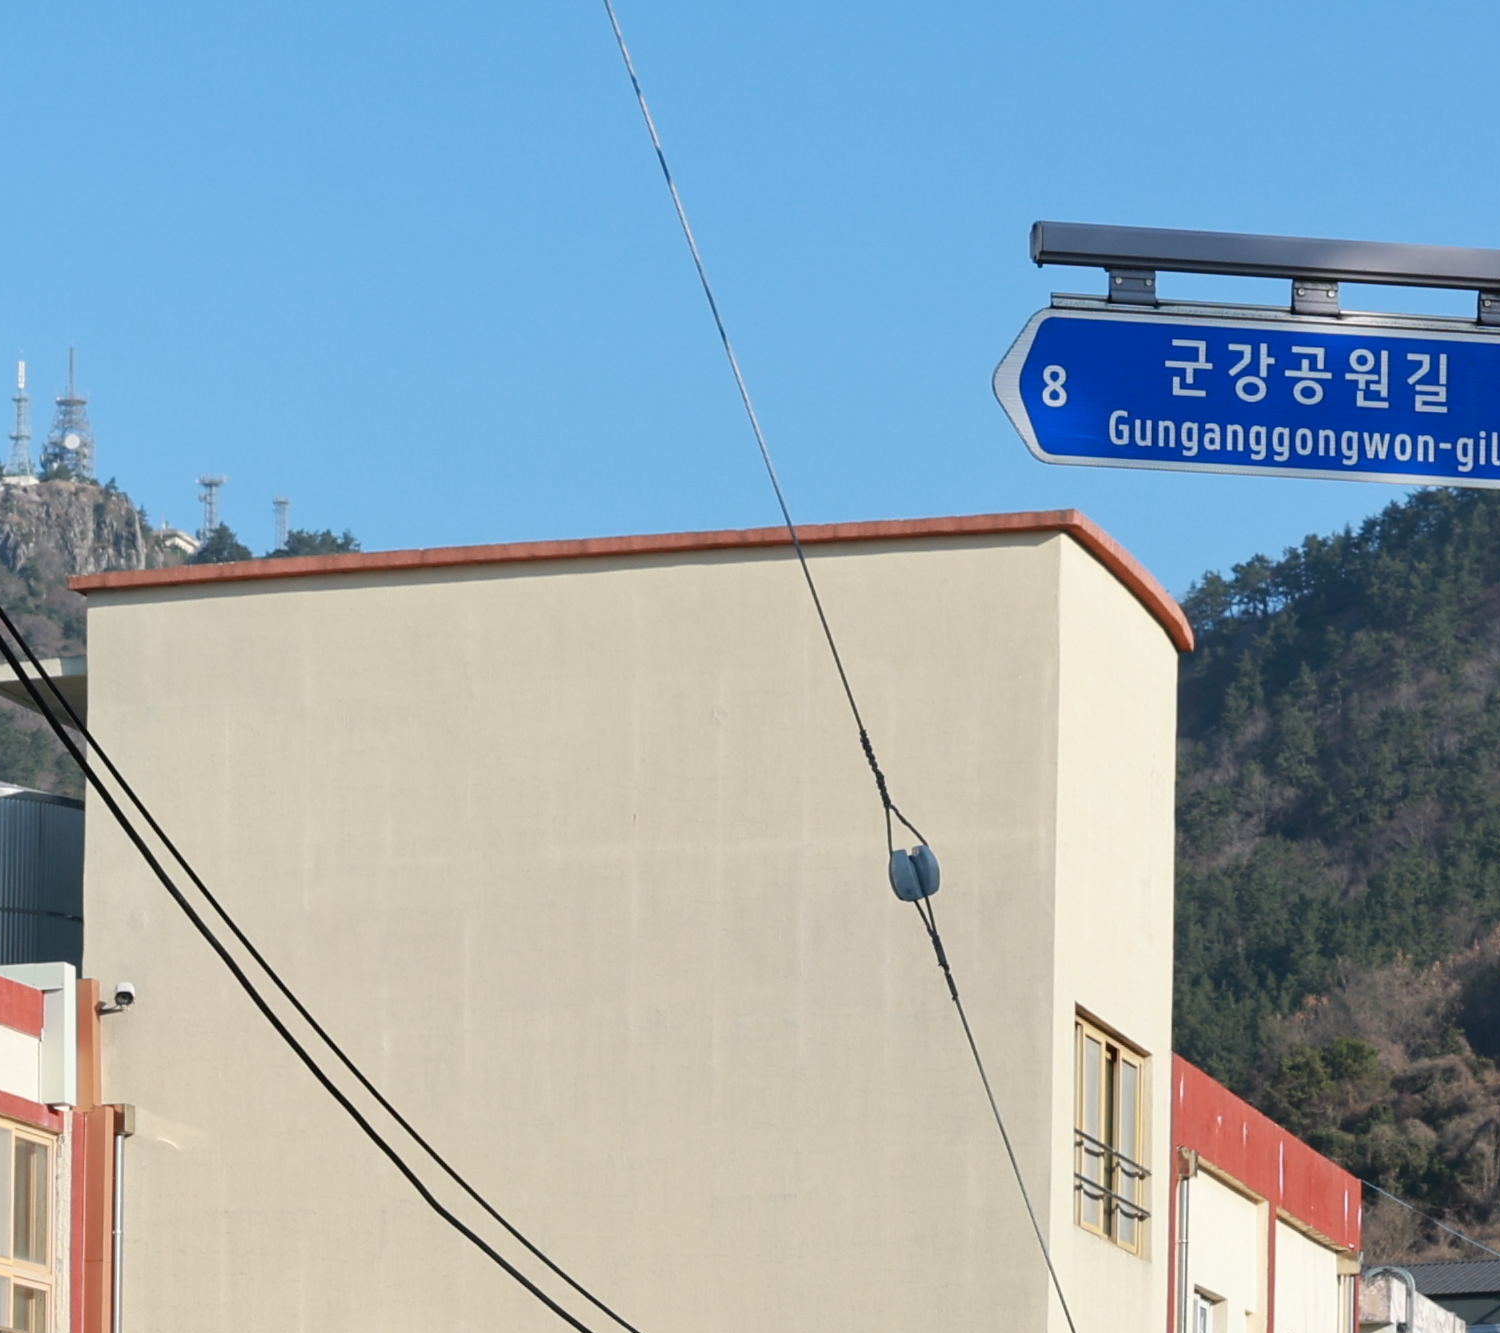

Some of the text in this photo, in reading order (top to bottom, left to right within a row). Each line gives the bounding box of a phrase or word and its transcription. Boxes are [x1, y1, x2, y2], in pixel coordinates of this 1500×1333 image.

[1042, 365, 1067, 407] 8
[1164, 338, 1448, 413] 군강공원길
[1109, 409, 1500, 472] Gunganggongwon-gil
